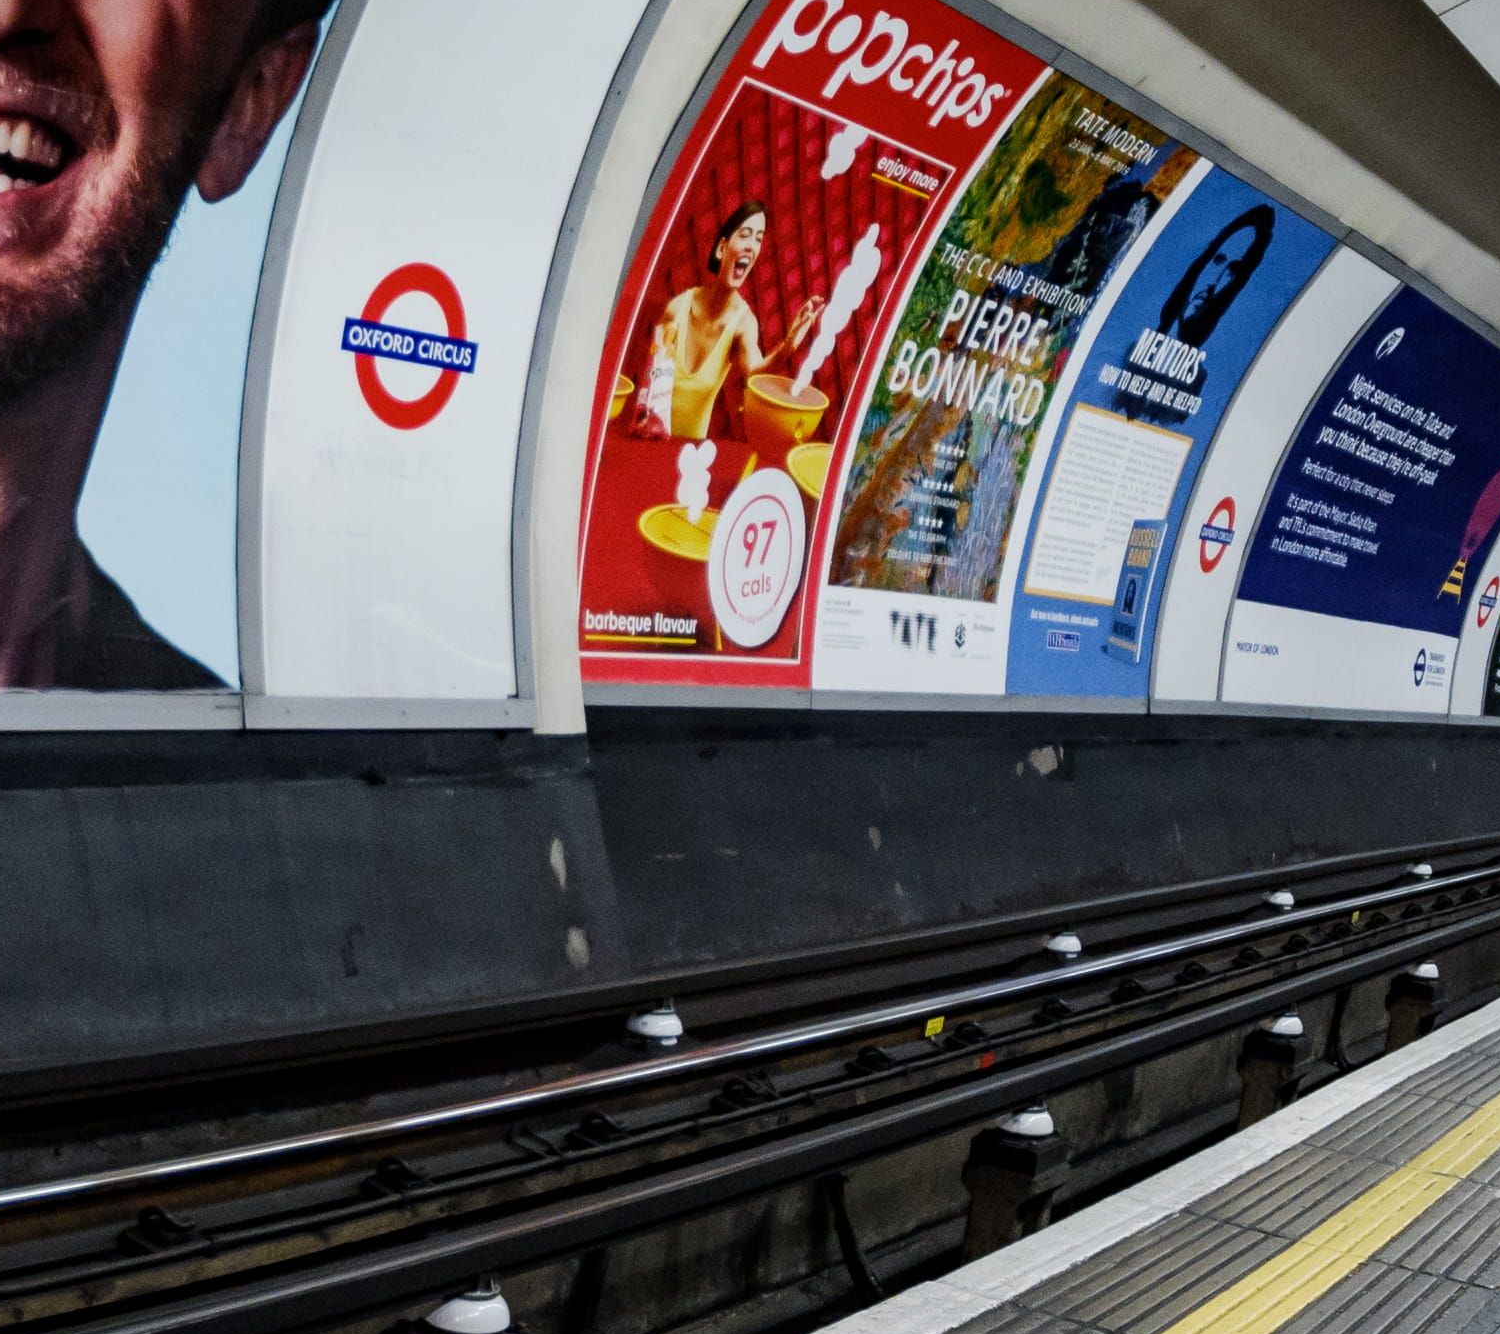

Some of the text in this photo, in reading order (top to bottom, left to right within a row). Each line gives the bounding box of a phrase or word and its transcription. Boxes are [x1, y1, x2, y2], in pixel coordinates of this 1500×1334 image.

[1075, 107, 1159, 166] TATE MODERN
[877, 155, 939, 191] enjoy more
[940, 243, 1090, 315] THE C C LAND EXHIBITION
[349, 325, 472, 366] OXFORD CIRCUS
[939, 289, 1049, 366] PIERRE
[1129, 327, 1206, 384] MENTORS
[888, 339, 1044, 426] BONNARD
[1118, 369, 1132, 390] TO
[1127, 373, 1151, 396] HELP
[1147, 379, 1166, 402] AND
[1163, 386, 1177, 406] BE
[1173, 390, 1202, 415] HELPED
[1348, 373, 1458, 440] Night services on the Tube and
[1316, 426, 1339, 445] you
[1336, 430, 1360, 453] think
[1356, 438, 1389, 466] because
[1333, 397, 1456, 466] London Overground are cheaper than
[743, 520, 777, 568] 97
[741, 573, 771, 598] cals
[585, 609, 697, 635] barbeque flavour
